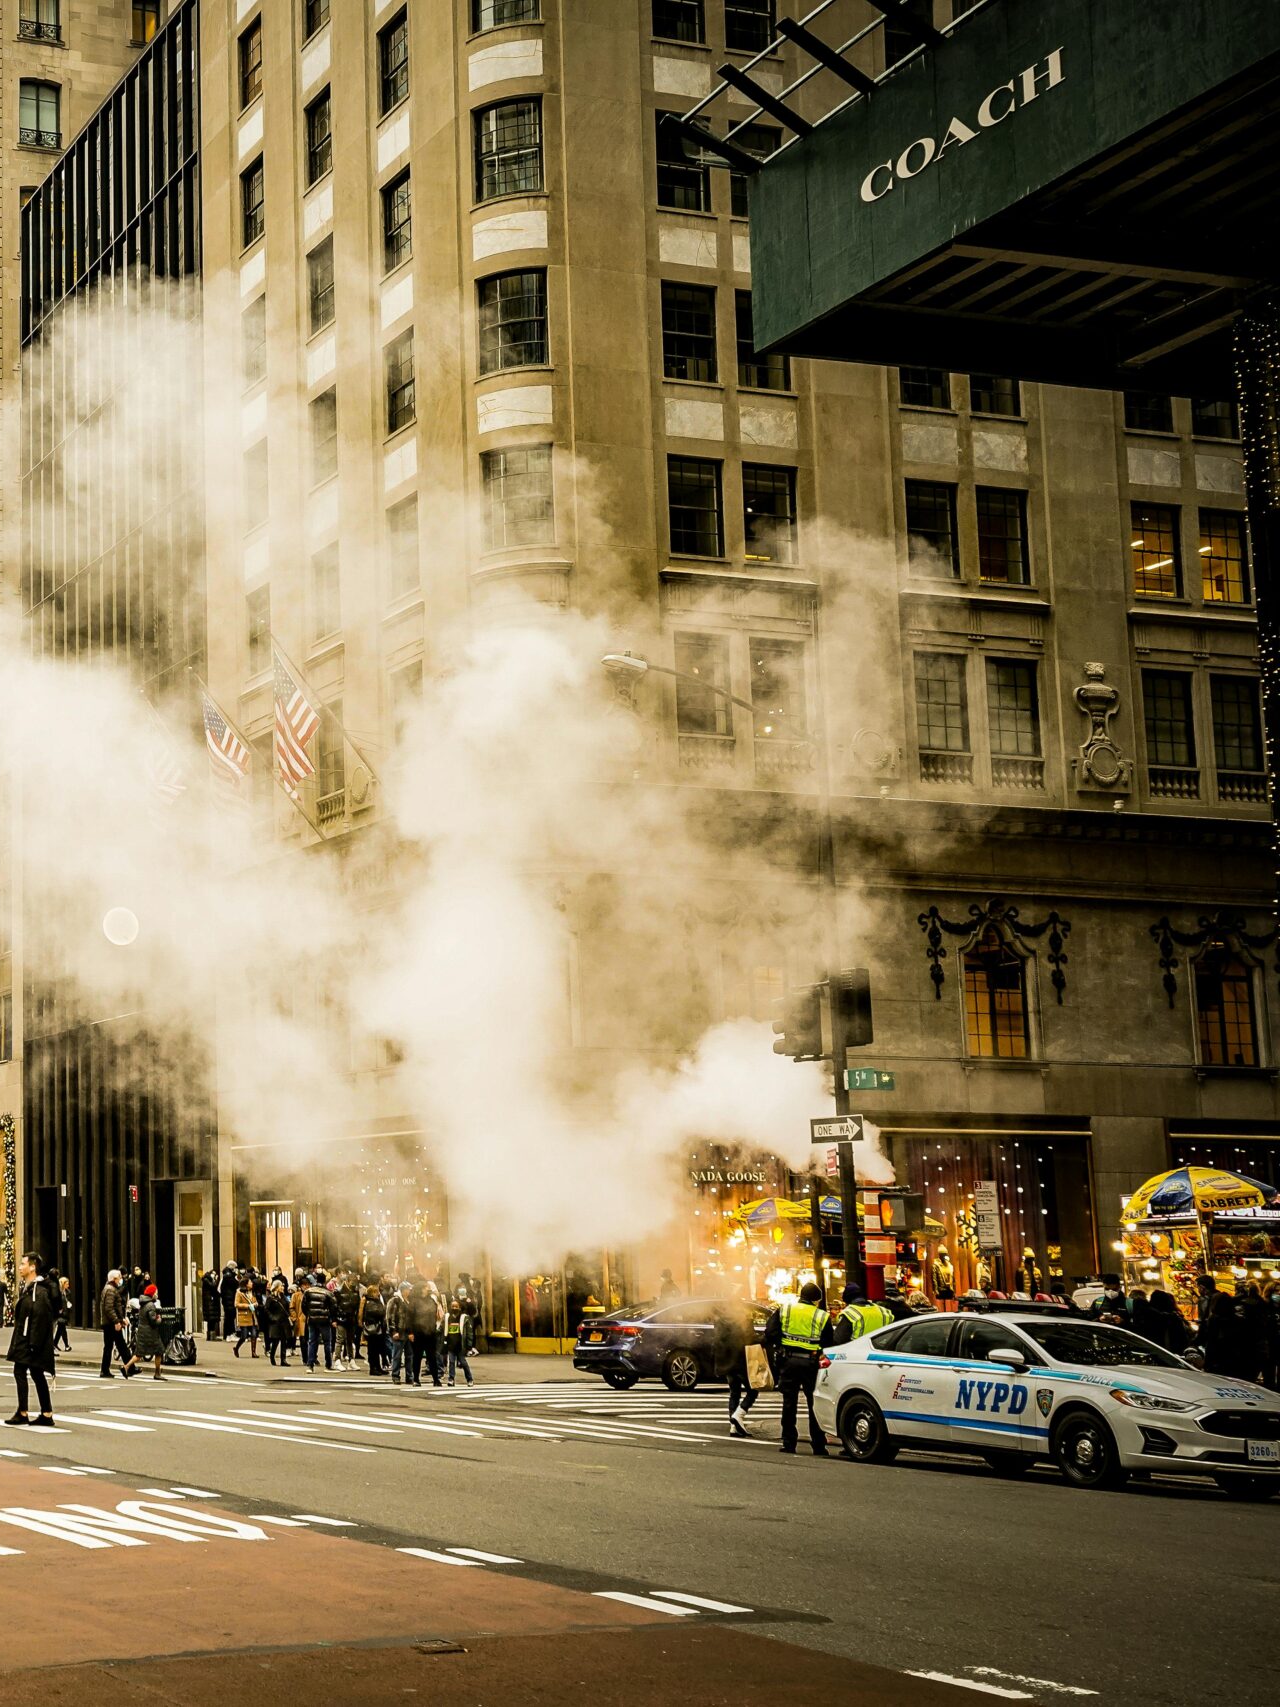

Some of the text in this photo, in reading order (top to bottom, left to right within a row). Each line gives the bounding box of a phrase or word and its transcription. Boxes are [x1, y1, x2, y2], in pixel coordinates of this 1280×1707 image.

[861, 46, 1065, 202] COACH
[855, 1071, 860, 1087] 5
[817, 1123, 855, 1136] ONE WAY
[727, 1172, 767, 1182] GOOSE
[1201, 1194, 1260, 1208] SABRETT
[1081, 1375, 1112, 1386] POLICE
[955, 1379, 1028, 1415] NYPD
[1250, 1446, 1270, 1457] 3260
